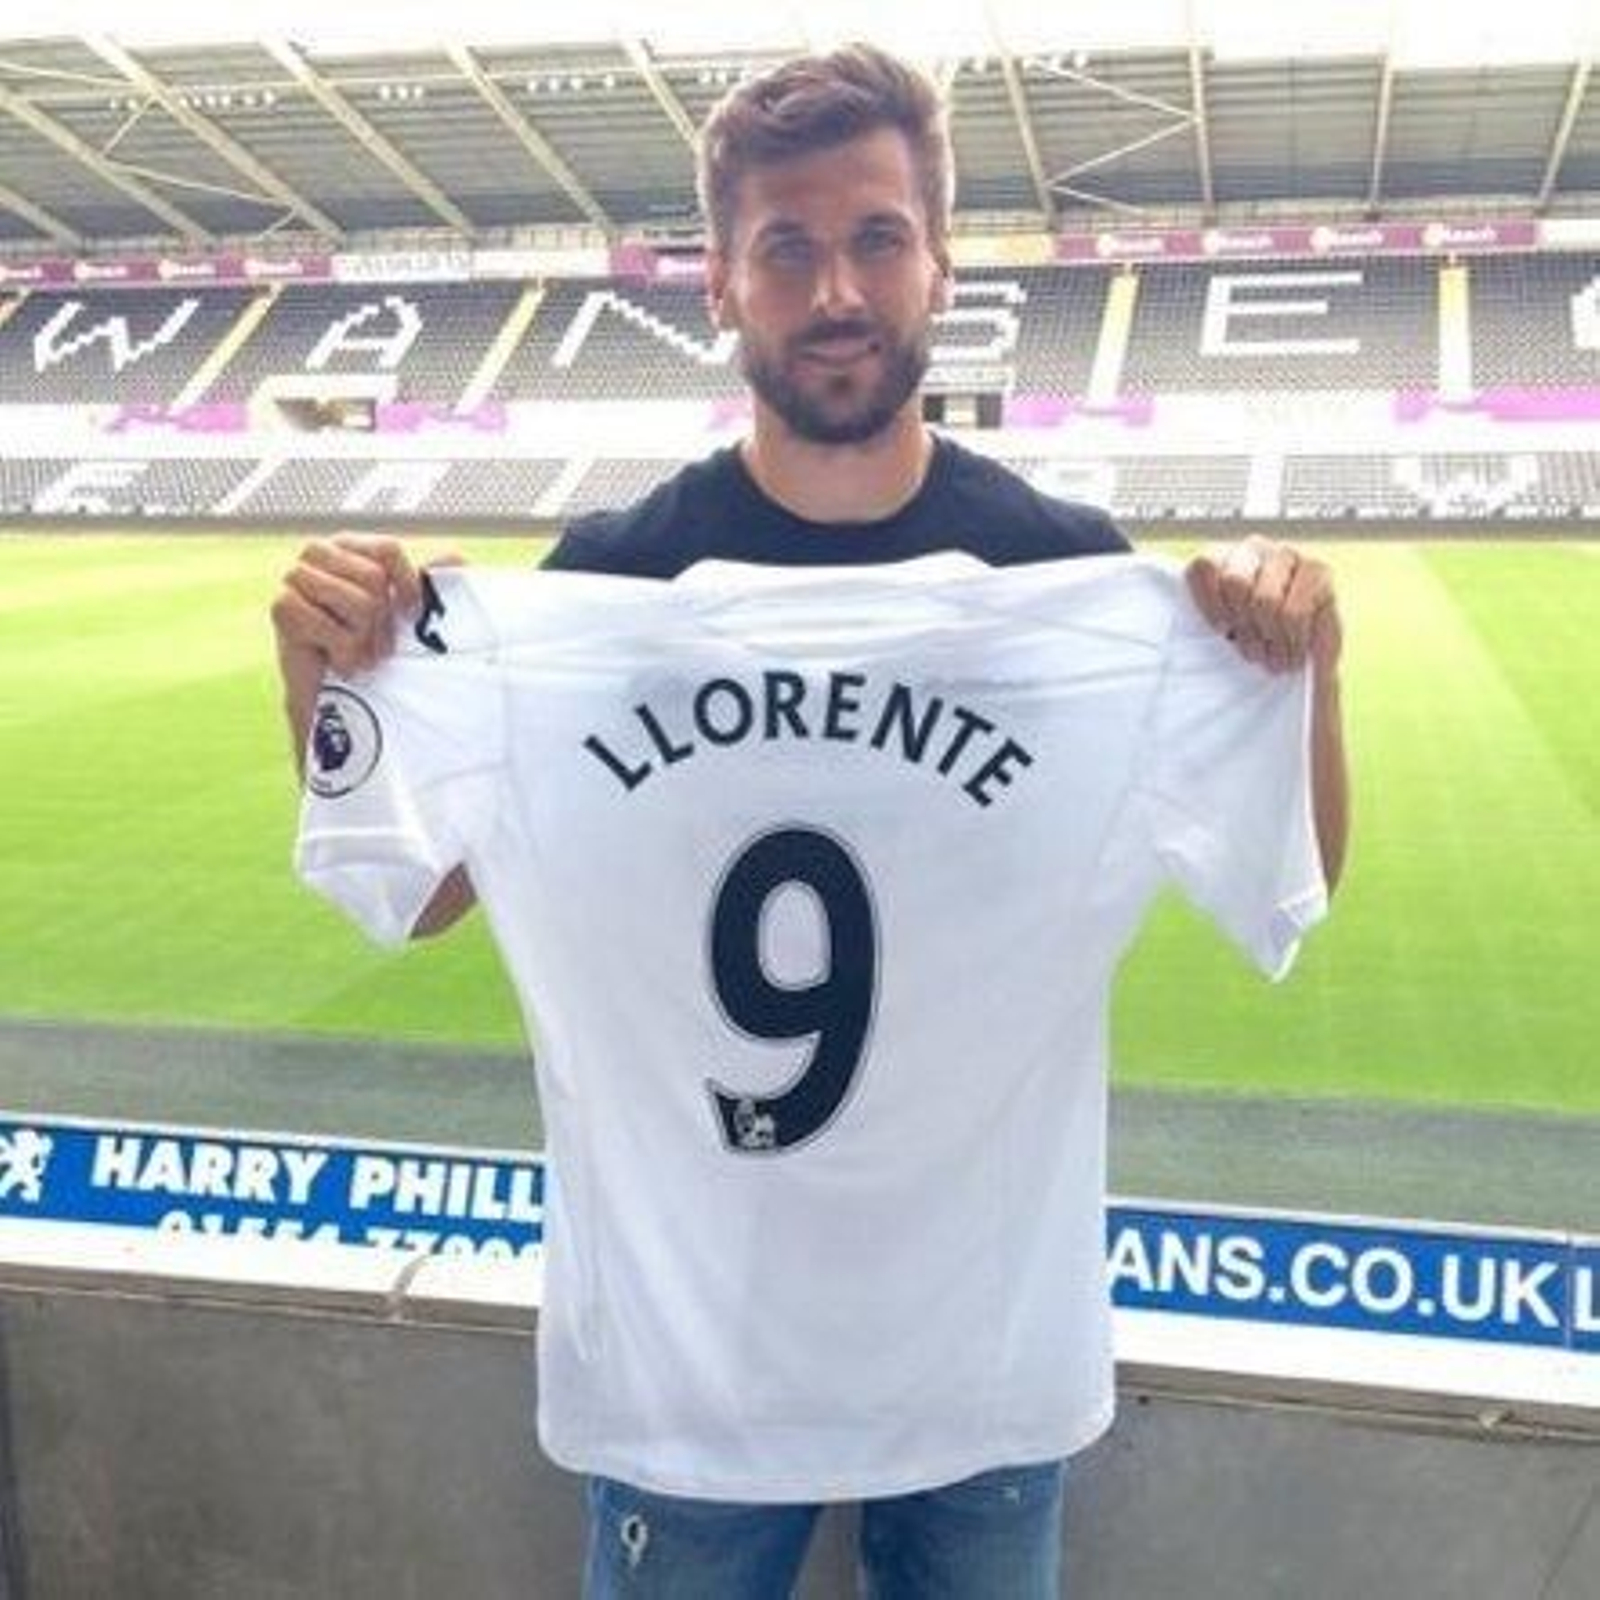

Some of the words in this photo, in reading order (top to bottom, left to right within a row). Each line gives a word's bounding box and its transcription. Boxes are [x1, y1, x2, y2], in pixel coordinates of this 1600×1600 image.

[583, 671, 1033, 808] LLORENTE
[707, 822, 880, 1156] 9
[91, 1136, 330, 1204] HARRY
[350, 1156, 542, 1222] PHILL
[1106, 1228, 1559, 1328] ANS.CO.UK
